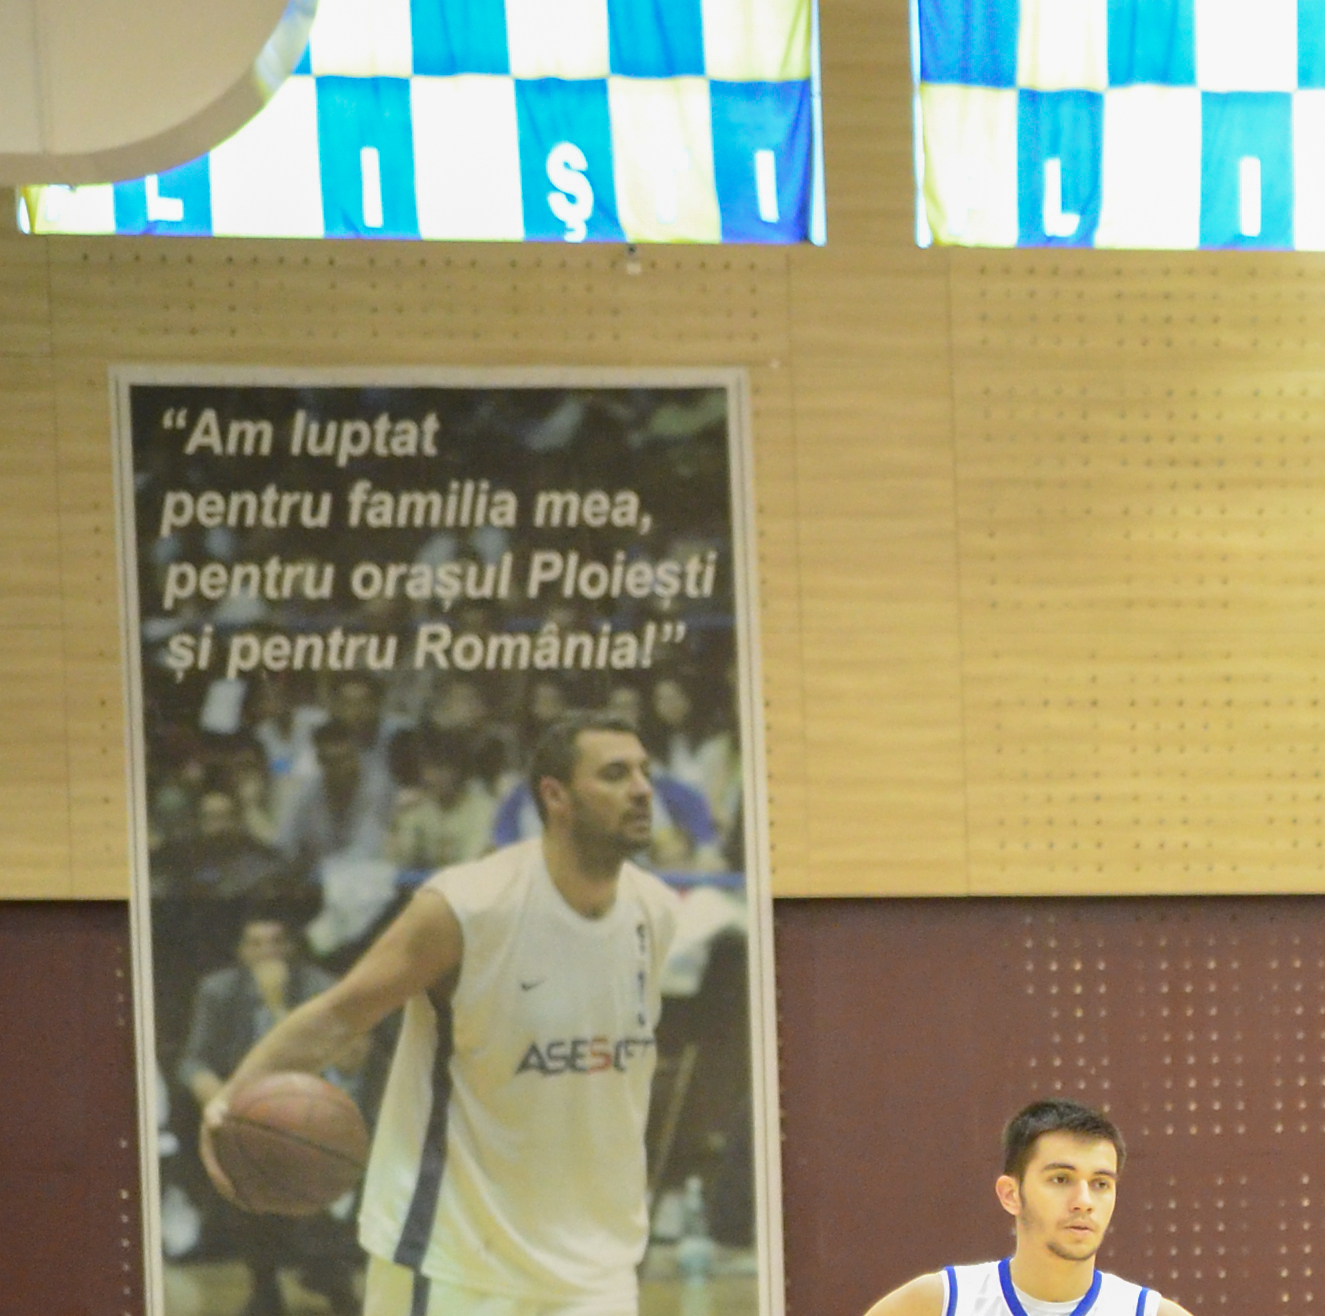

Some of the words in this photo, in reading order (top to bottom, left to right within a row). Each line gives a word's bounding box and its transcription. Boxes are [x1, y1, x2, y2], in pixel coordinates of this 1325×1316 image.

[289, 409, 441, 468] luptat
[160, 484, 332, 538] pentru
[346, 479, 518, 530] familia
[534, 489, 654, 534] mea,
[163, 556, 334, 610] pentru
[226, 626, 399, 680] pentru
